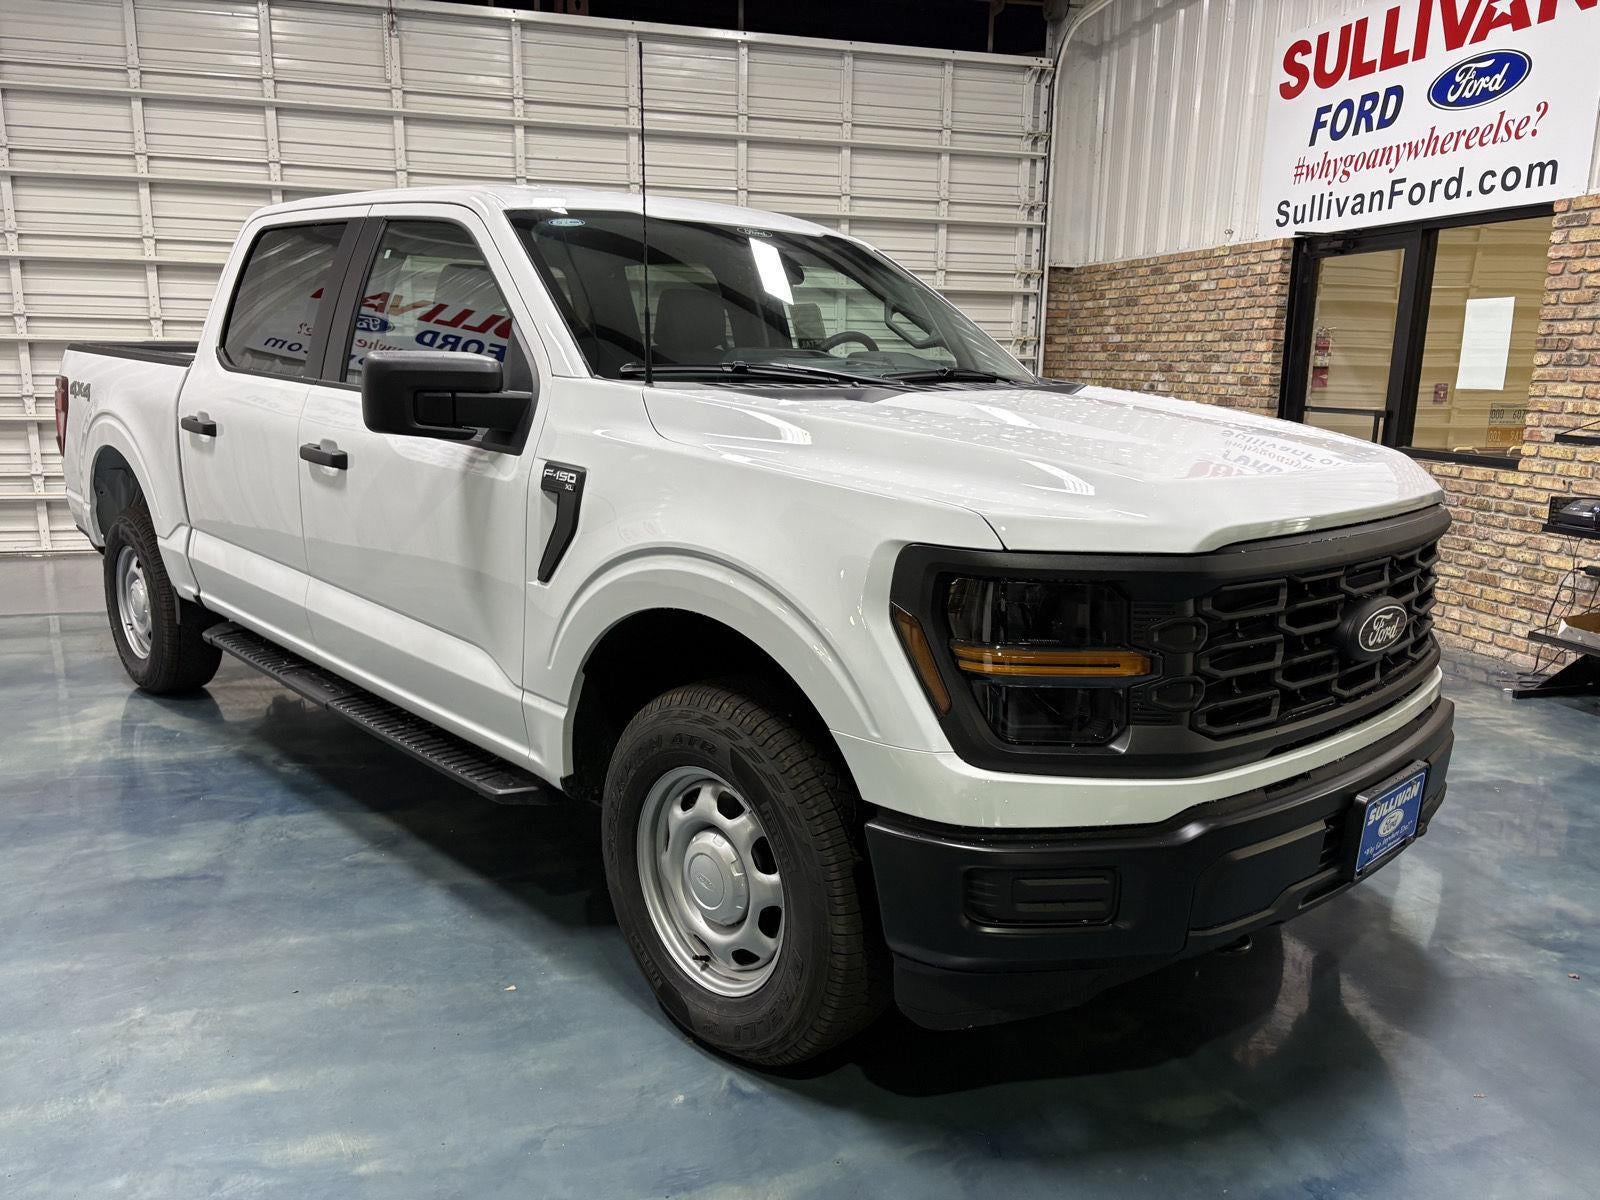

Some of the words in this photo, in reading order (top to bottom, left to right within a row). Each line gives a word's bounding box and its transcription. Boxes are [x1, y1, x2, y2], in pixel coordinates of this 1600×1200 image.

[1446, 58, 1511, 101] Ford
[1308, 84, 1404, 147] FORD
[1293, 100, 1549, 186] #whygoanywhereelse?
[1275, 158, 1558, 228] SullivanFord.com
[564, 483, 574, 491] XL
[1368, 612, 1400, 647] Ford
[1367, 780, 1421, 826] SULLIVAN
